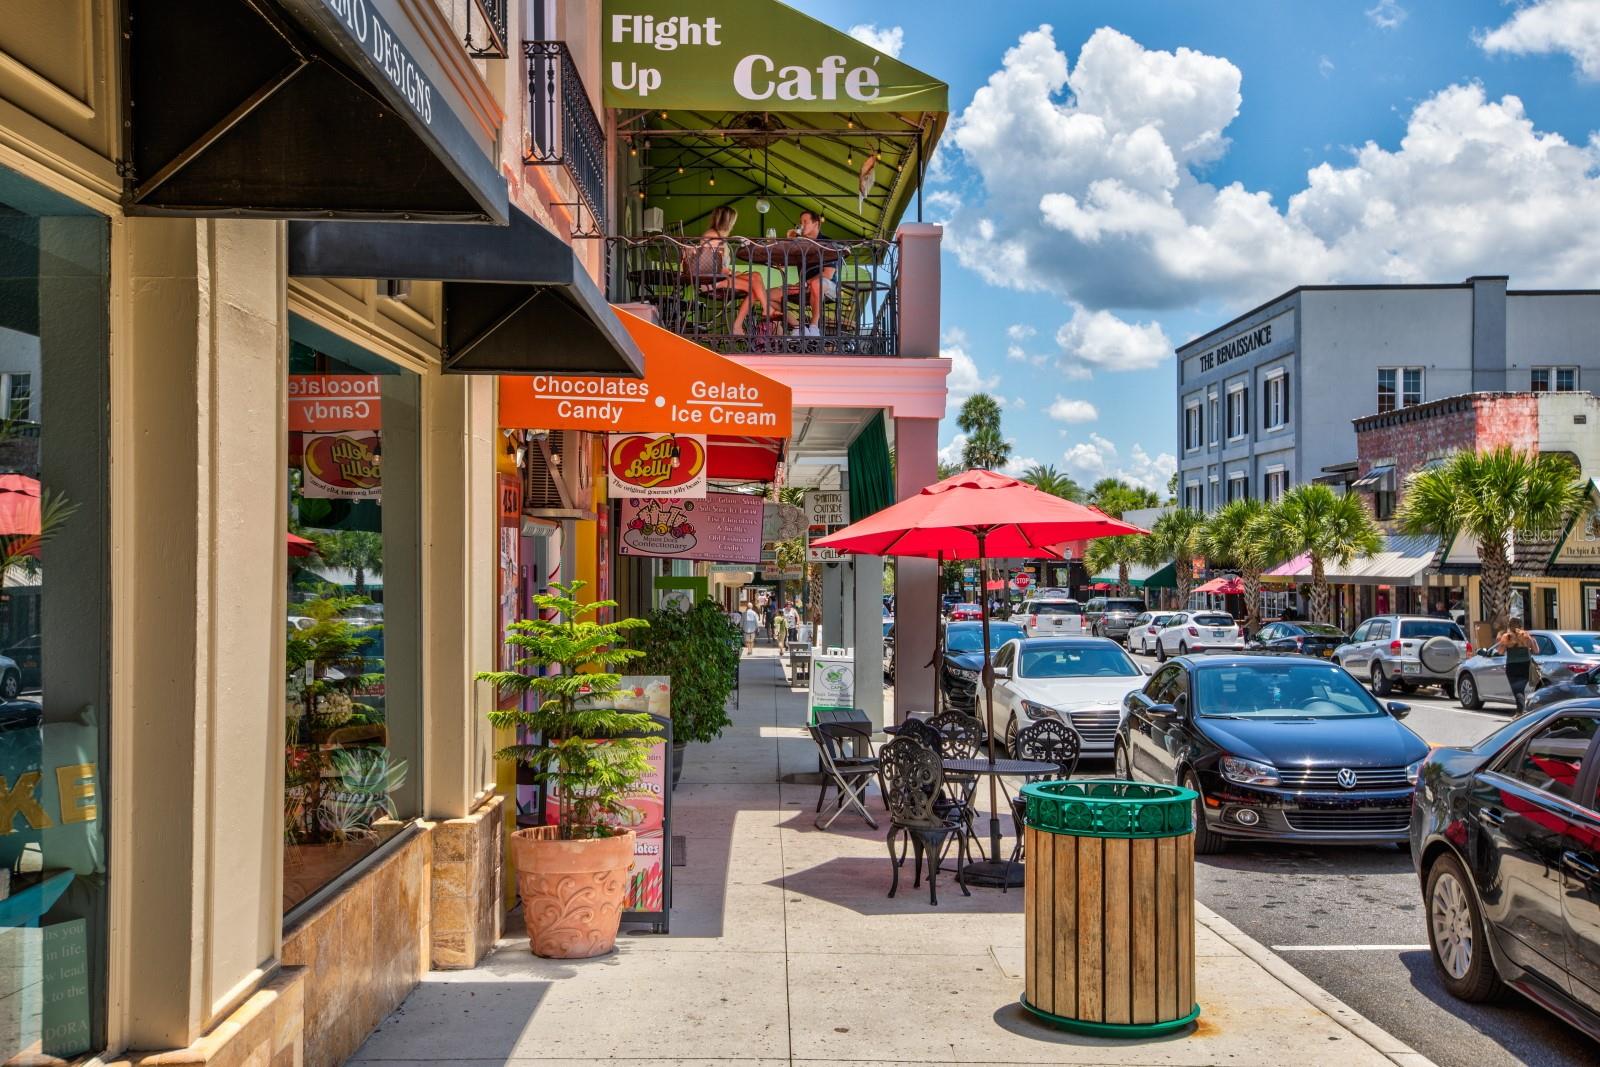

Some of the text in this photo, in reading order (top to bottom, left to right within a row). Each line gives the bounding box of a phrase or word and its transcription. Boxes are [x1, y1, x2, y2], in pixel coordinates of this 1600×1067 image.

[611, 14, 722, 51] Flight
[373, 16, 431, 124] DESIGNS
[611, 62, 662, 96] Up
[733, 53, 880, 101] Café
[1200, 325, 1272, 373] THE RENAISSANCE
[533, 375, 650, 396] Chocolates
[691, 381, 759, 400] Gelato
[557, 401, 623, 424] Candy
[671, 405, 777, 426] Ice Cream
[625, 458, 673, 488] Belly
[623, 485, 647, 494] original
[673, 486, 686, 496] jelly
[814, 504, 843, 514] OUTSIDE
[814, 514, 843, 524] THE LINES
[1566, 546, 1575, 554] The
[1576, 546, 1590, 557] Spice
[67, 985, 86, 997] the
